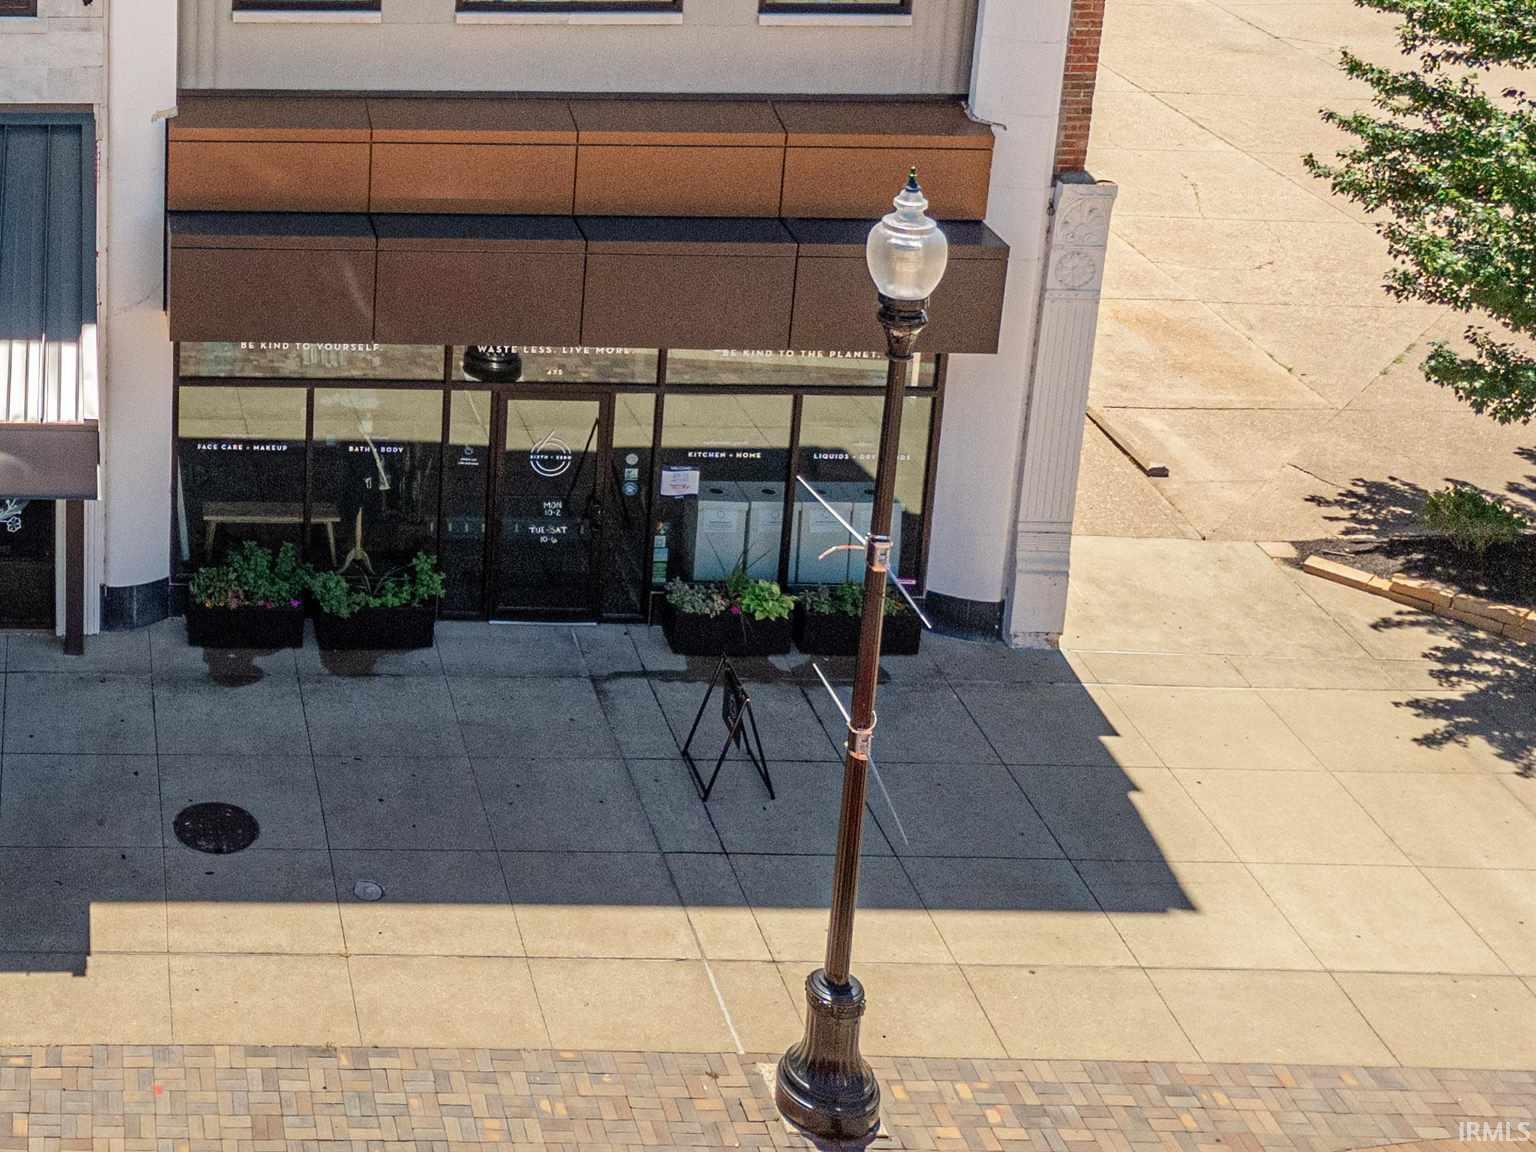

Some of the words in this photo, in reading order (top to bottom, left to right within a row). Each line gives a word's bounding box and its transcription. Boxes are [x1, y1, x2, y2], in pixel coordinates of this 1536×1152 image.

[240, 341, 255, 350] BE
[260, 341, 290, 350] KIND
[295, 342, 311, 351] TO
[316, 342, 383, 352] YOURSELF.
[477, 344, 518, 354] WASTE
[562, 346, 590, 354] LIVE
[721, 349, 737, 357] BE
[742, 349, 771, 358] KIND
[778, 349, 795, 358] TO
[800, 350, 824, 358] THE
[829, 350, 882, 359] PLANET.
[196, 443, 217, 451] FACE
[220, 443, 244, 451] CARE
[252, 444, 288, 452] MAKEUP
[348, 445, 371, 453] BATH
[687, 451, 727, 459] KITCHEN
[735, 452, 762, 460] HOME
[813, 452, 850, 461] LIQUIDS
